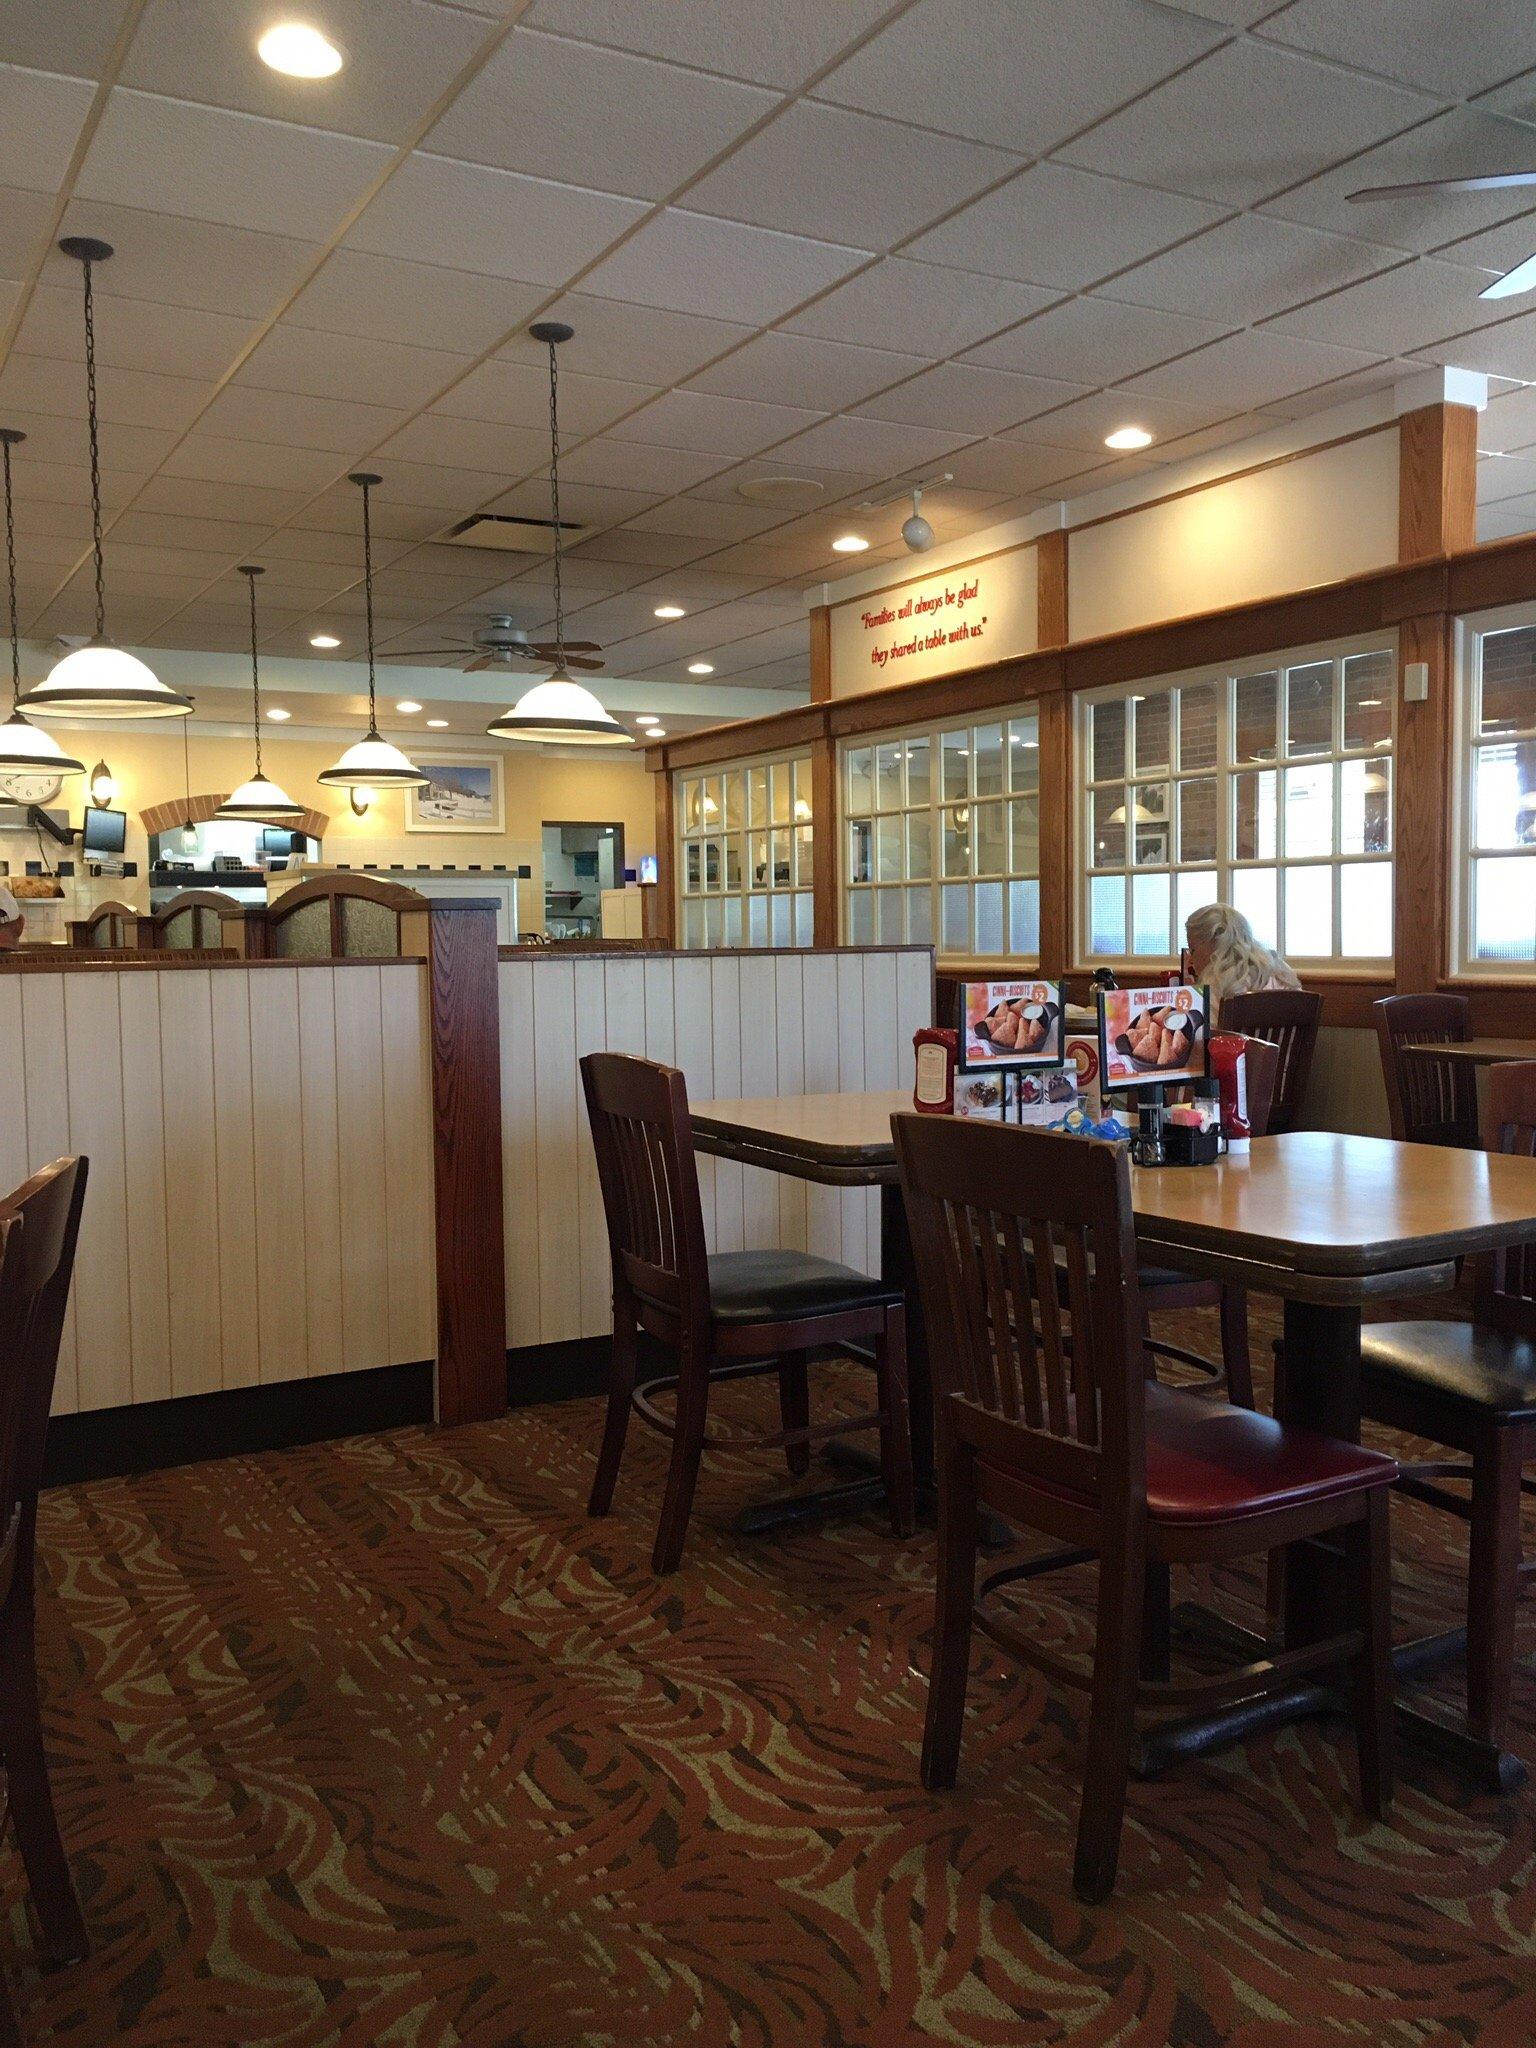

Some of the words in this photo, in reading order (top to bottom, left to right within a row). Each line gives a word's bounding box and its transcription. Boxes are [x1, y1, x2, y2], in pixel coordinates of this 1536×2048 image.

[897, 598, 913, 620] will
[914, 596, 943, 616] always
[945, 587, 955, 606] be
[957, 578, 979, 608] glad
[871, 647, 888, 668] they
[890, 635, 917, 660] shared
[917, 639, 924, 652] a
[925, 628, 947, 649] table
[948, 621, 969, 644] with
